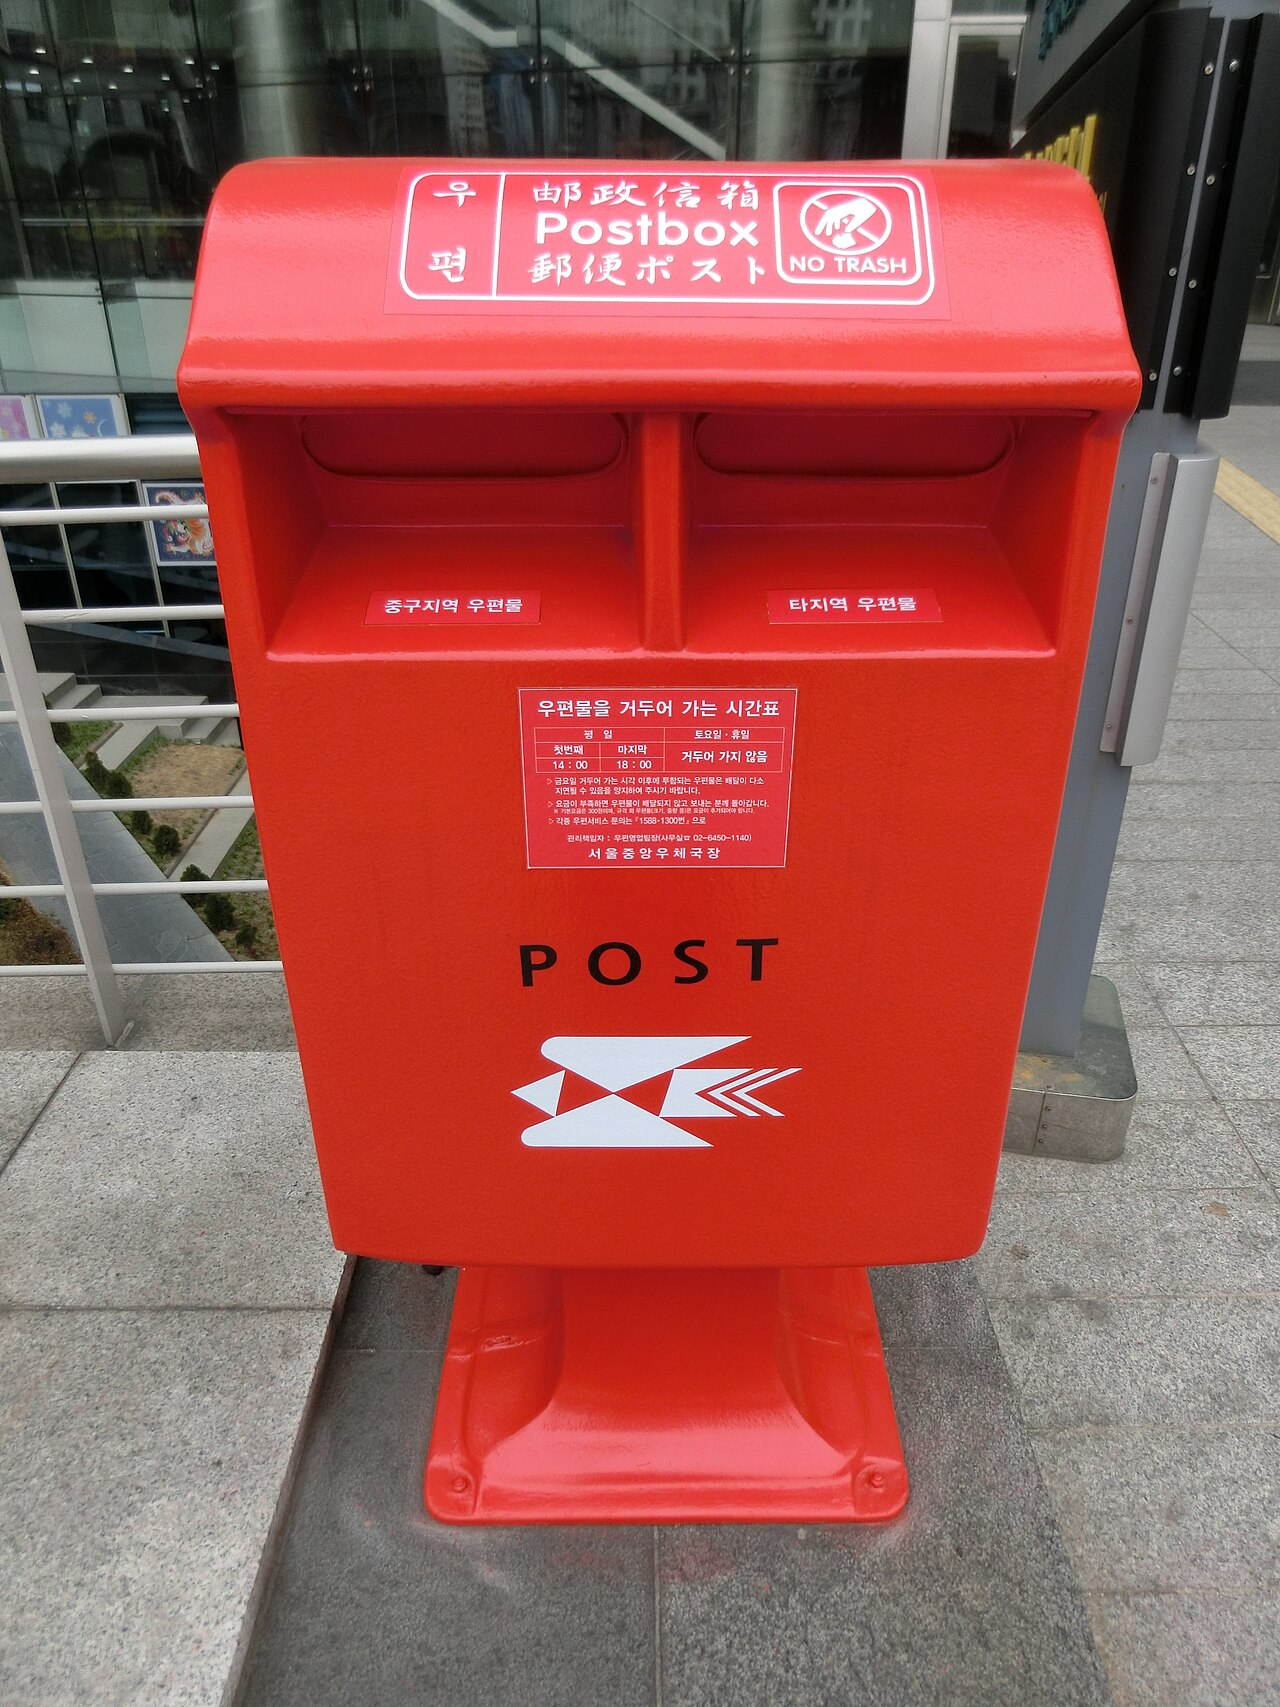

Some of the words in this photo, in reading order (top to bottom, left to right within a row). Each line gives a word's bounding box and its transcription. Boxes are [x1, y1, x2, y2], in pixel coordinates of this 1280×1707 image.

[533, 181, 760, 211] 邮政信箱
[536, 212, 759, 247] Postbox
[528, 252, 765, 287] 郵便ポスト
[789, 255, 826, 273] NO
[834, 256, 907, 275] TRASH
[384, 597, 460, 615] 중구지역
[467, 598, 523, 615] 우편물
[788, 596, 849, 613] 타지역
[856, 596, 917, 613] 우편물
[537, 699, 611, 717] 우편물을
[619, 700, 673, 717] 거두어
[682, 700, 718, 717] 가는
[725, 700, 780, 717] 시간표
[553, 744, 584, 755] 첫번째
[618, 744, 647, 755] 마지막
[681, 751, 714, 763] 거두어
[719, 751, 741, 763] 가지
[745, 751, 768, 763] 않음
[555, 777, 577, 785] 금요일
[579, 777, 601, 785] 거두어
[604, 777, 618, 785] 가는
[621, 777, 636, 785] 시각
[638, 777, 660, 785] 이후에
[693, 777, 723, 785] 우편물은
[724, 777, 747, 785] 배달이
[749, 777, 764, 785] 다소
[555, 786, 577, 795] 지연될
[579, 786, 587, 795] 수
[589, 786, 611, 795] 있음을
[645, 786, 667, 795] 주시기
[669, 786, 700, 795] 바랍니다.
[555, 799, 578, 808] 요금이
[580, 799, 609, 808] 부족하면
[611, 799, 640, 808] 우편물이
[642, 799, 671, 808] 배달되지
[673, 799, 689, 807] 않고
[691, 799, 712, 807] 보내는
[556, 817, 571, 825] 각종
[573, 817, 609, 825] 우편서비스
[611, 817, 633, 825] 문의는
[519, 938, 779, 987] POST
